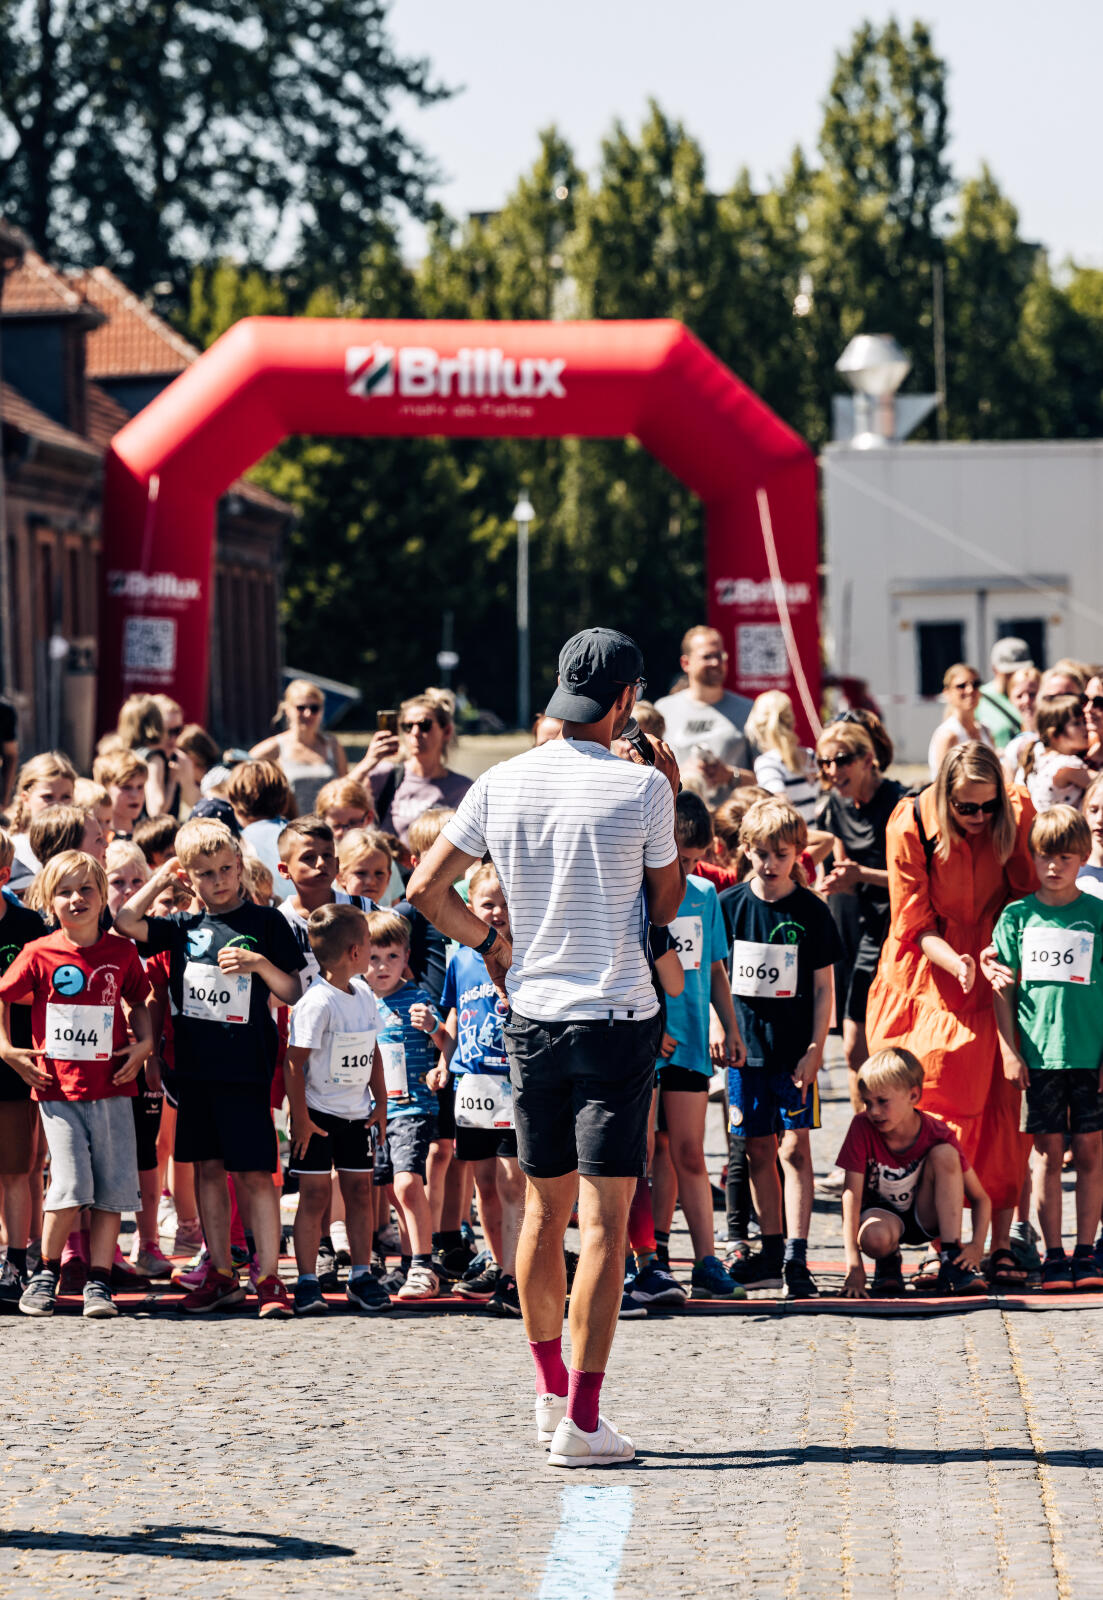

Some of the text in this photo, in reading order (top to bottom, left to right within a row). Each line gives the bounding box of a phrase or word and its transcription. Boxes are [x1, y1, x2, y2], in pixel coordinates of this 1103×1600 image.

[398, 347, 567, 398] Brillux
[735, 578, 811, 604] Brilux
[1031, 948, 1075, 967] 1036
[739, 962, 780, 984] 1069
[189, 986, 231, 1007] 1040
[54, 1028, 99, 1047] 1044
[460, 1096, 495, 1111] 1010
